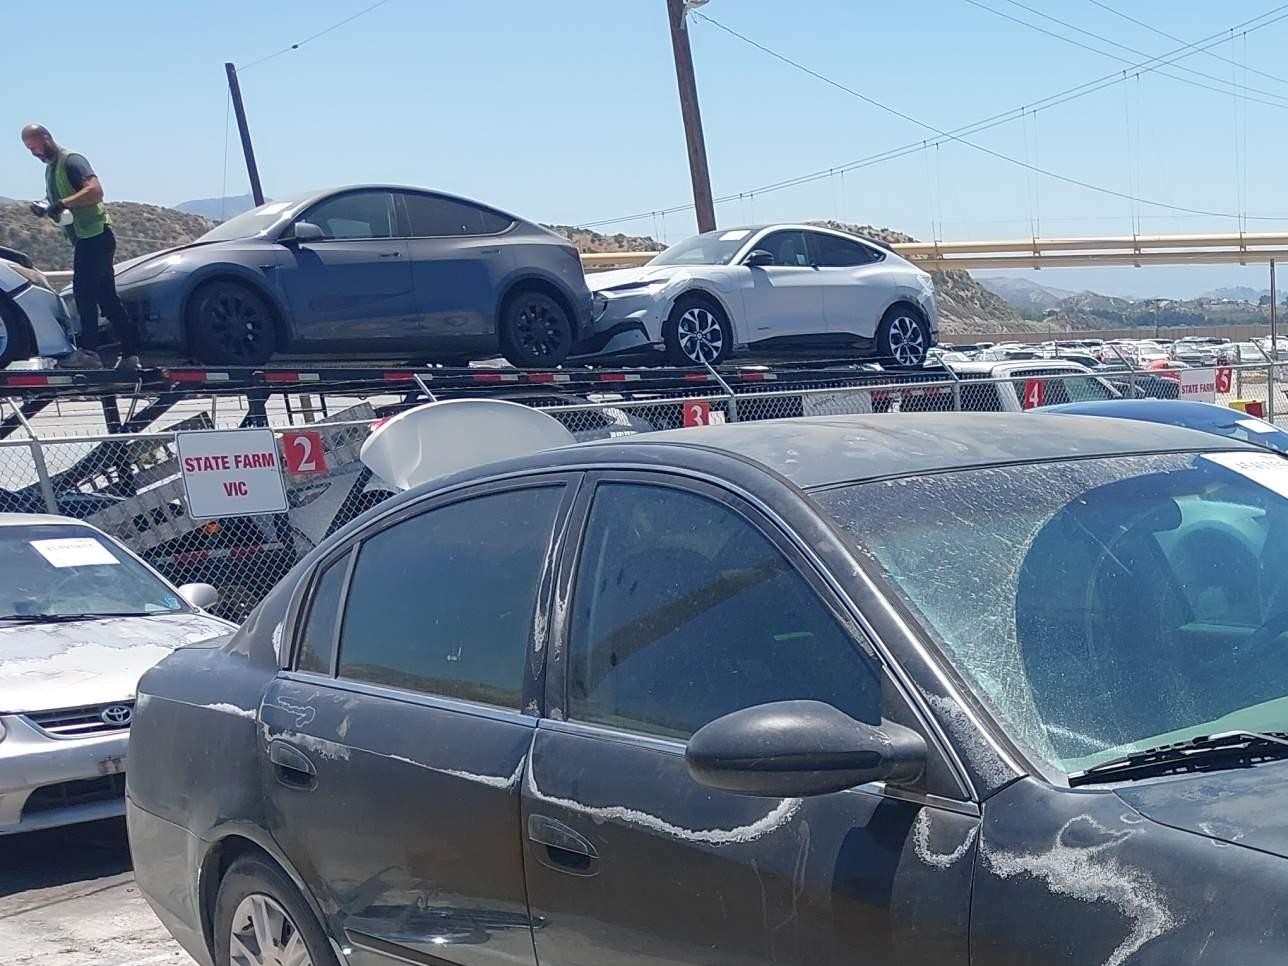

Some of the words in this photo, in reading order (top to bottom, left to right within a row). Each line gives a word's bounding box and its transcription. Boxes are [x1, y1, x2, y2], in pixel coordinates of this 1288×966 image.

[1182, 384, 1198, 394] STATE
[1199, 383, 1215, 393] FARM
[1219, 369, 1230, 391] 5
[1029, 382, 1040, 408] 4
[690, 404, 703, 426] 3
[184, 455, 230, 472] STATE
[234, 453, 275, 469] FARM
[293, 436, 316, 471] 2
[223, 481, 248, 497] VIC
